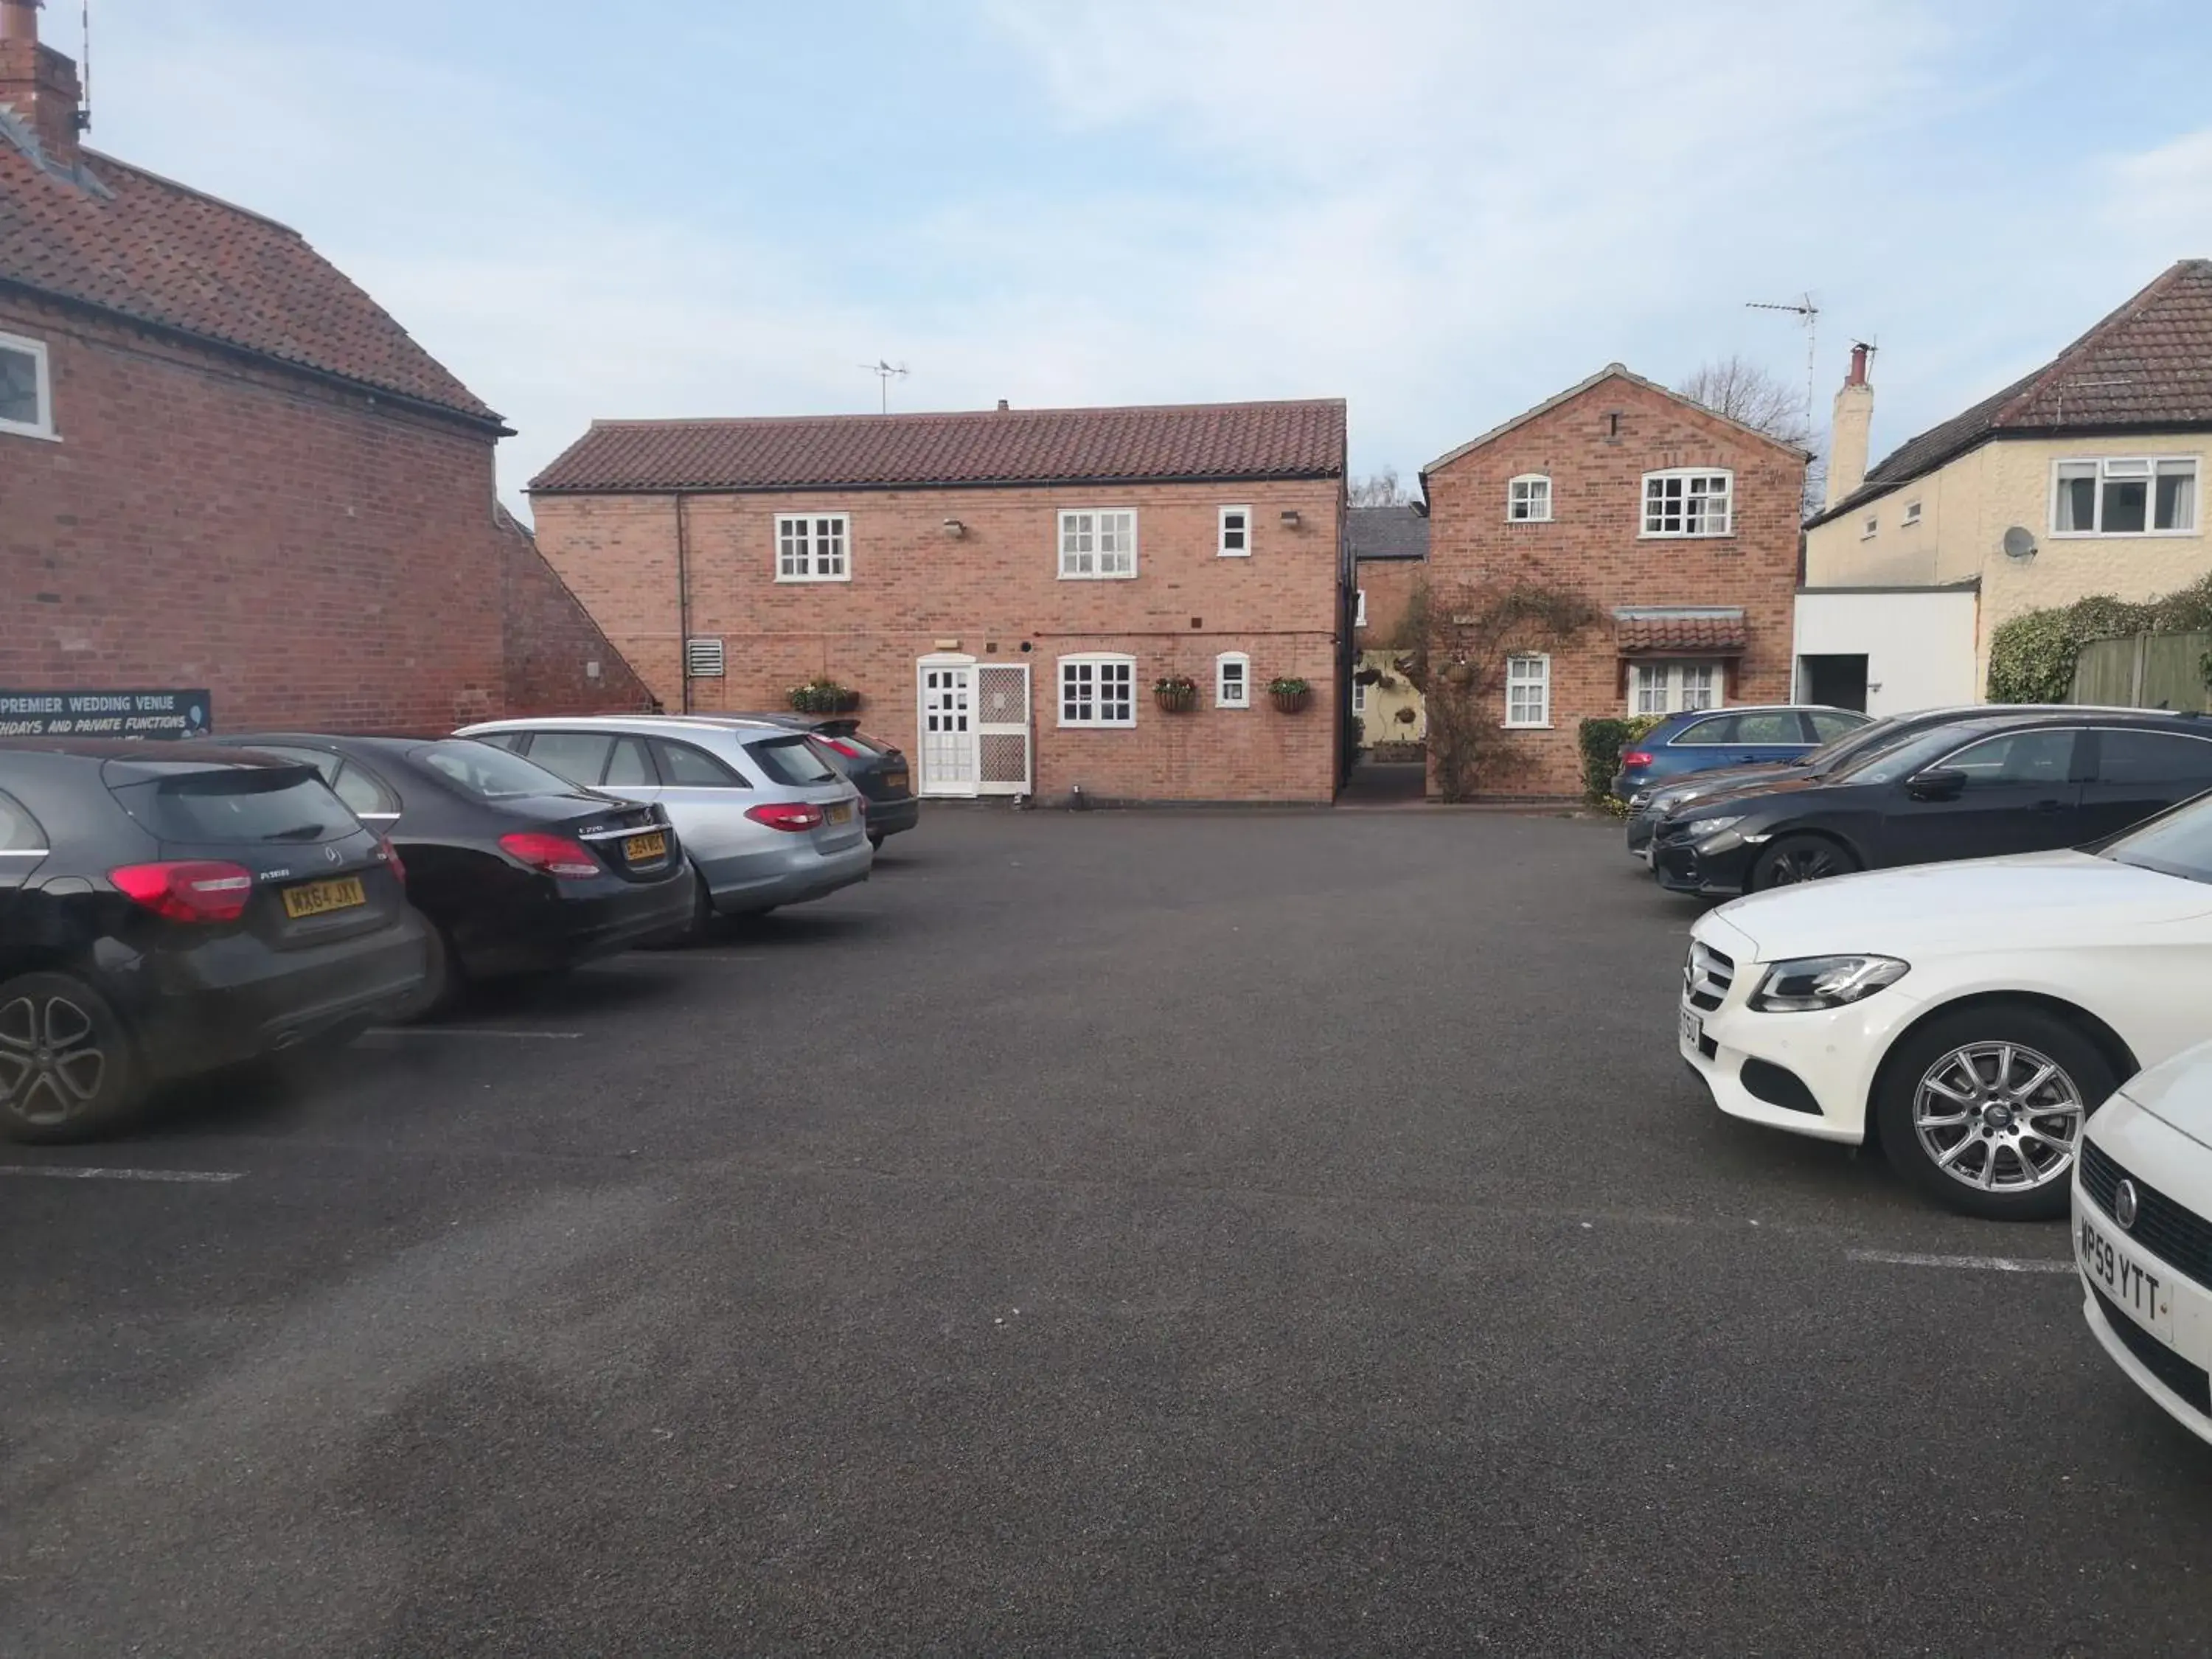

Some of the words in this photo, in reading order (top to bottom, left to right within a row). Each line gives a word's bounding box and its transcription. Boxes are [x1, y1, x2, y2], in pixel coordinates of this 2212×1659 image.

[0, 698, 62, 714] PREMIER
[69, 696, 131, 712] WEDDING
[136, 695, 174, 710] VENUE
[0, 720, 43, 737] HDAYS
[48, 720, 72, 734] AND
[75, 718, 122, 732] PRIVATE
[125, 715, 186, 730] FUNCTIONS
[2119, 1253, 2159, 1321] YTT
